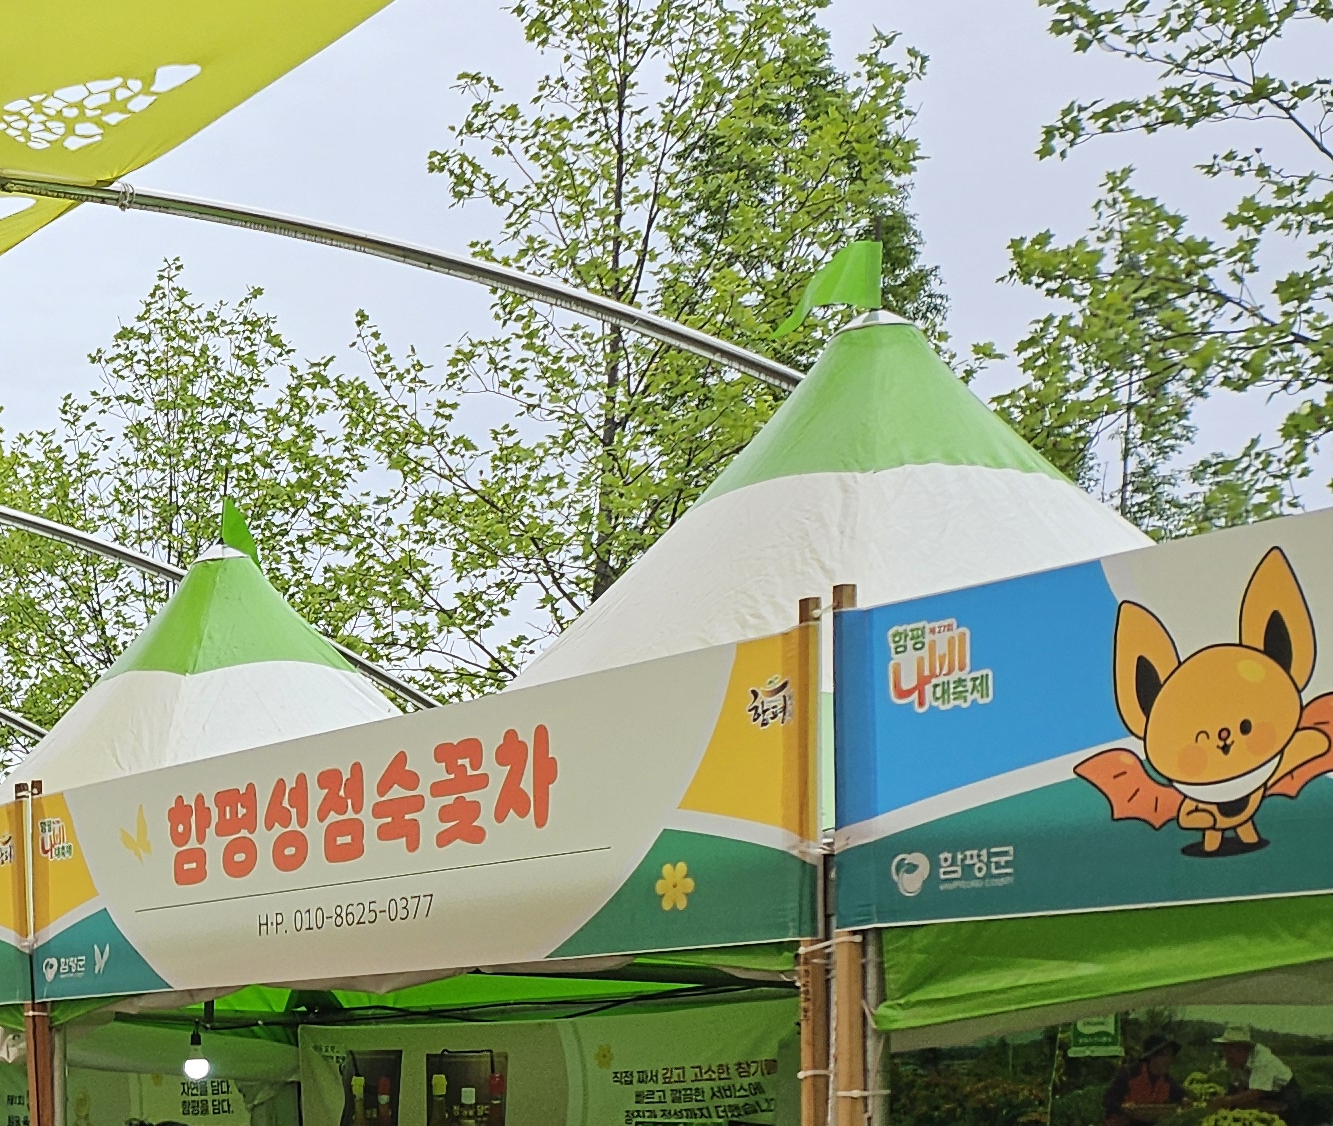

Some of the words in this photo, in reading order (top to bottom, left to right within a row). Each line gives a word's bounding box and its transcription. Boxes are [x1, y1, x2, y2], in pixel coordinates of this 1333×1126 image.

[891, 625, 926, 656] 함평
[931, 672, 990, 706] 대축제
[167, 723, 559, 887] 함평성점숙꽃차
[938, 845, 1014, 880] 함평군
[292, 893, 435, 933] 010-8625-0377
[210, 1079, 233, 1096] 담다.
[612, 1070, 634, 1086] 직접
[661, 1065, 686, 1085] 깊고
[690, 1063, 732, 1083] 고소한
[710, 1081, 766, 1100] 서비스에
[211, 1099, 234, 1115] 담다.
